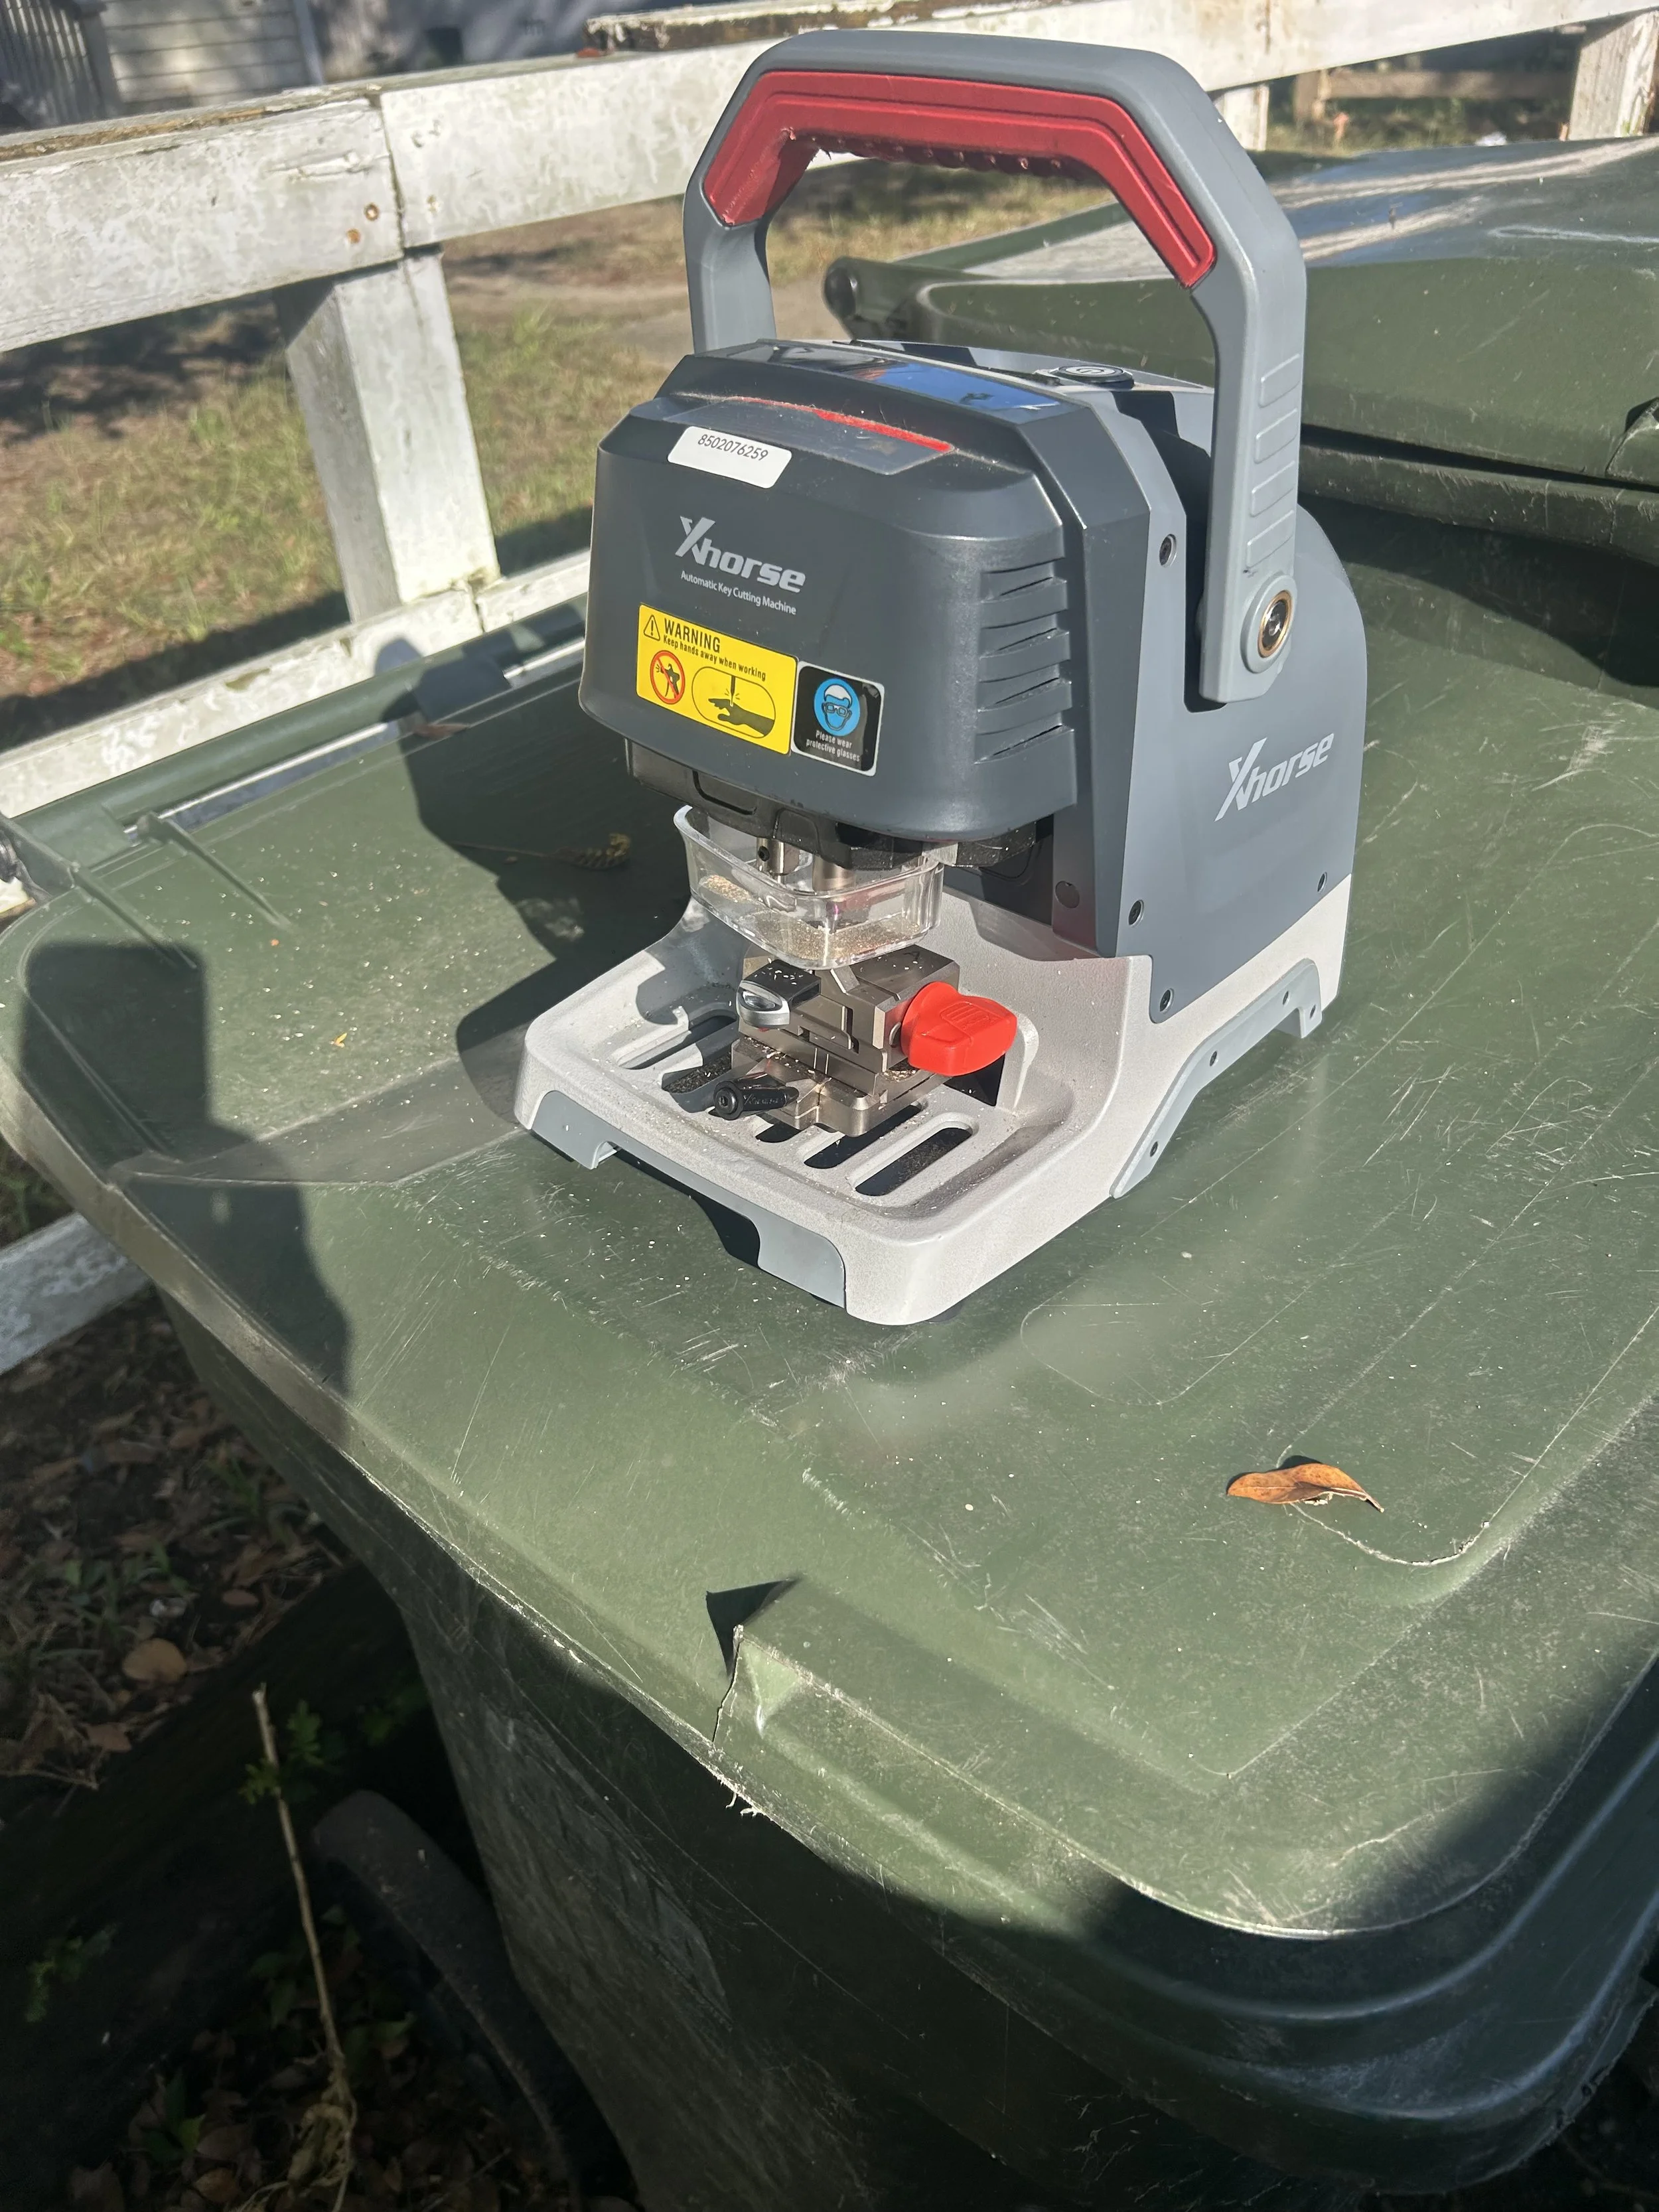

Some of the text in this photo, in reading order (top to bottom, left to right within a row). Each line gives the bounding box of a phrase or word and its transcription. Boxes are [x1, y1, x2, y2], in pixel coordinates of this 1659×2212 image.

[698, 434, 768, 461] 8502076259
[675, 516, 806, 593] Xhorse
[681, 570, 796, 615] Automatic Key Cutting Machine
[664, 618, 721, 654] WARNING
[664, 634, 766, 682] Keep hands away when working
[806, 739, 860, 762] protective glasses
[816, 730, 852, 749] Please wear
[1214, 733, 1334, 822] Xhorse
